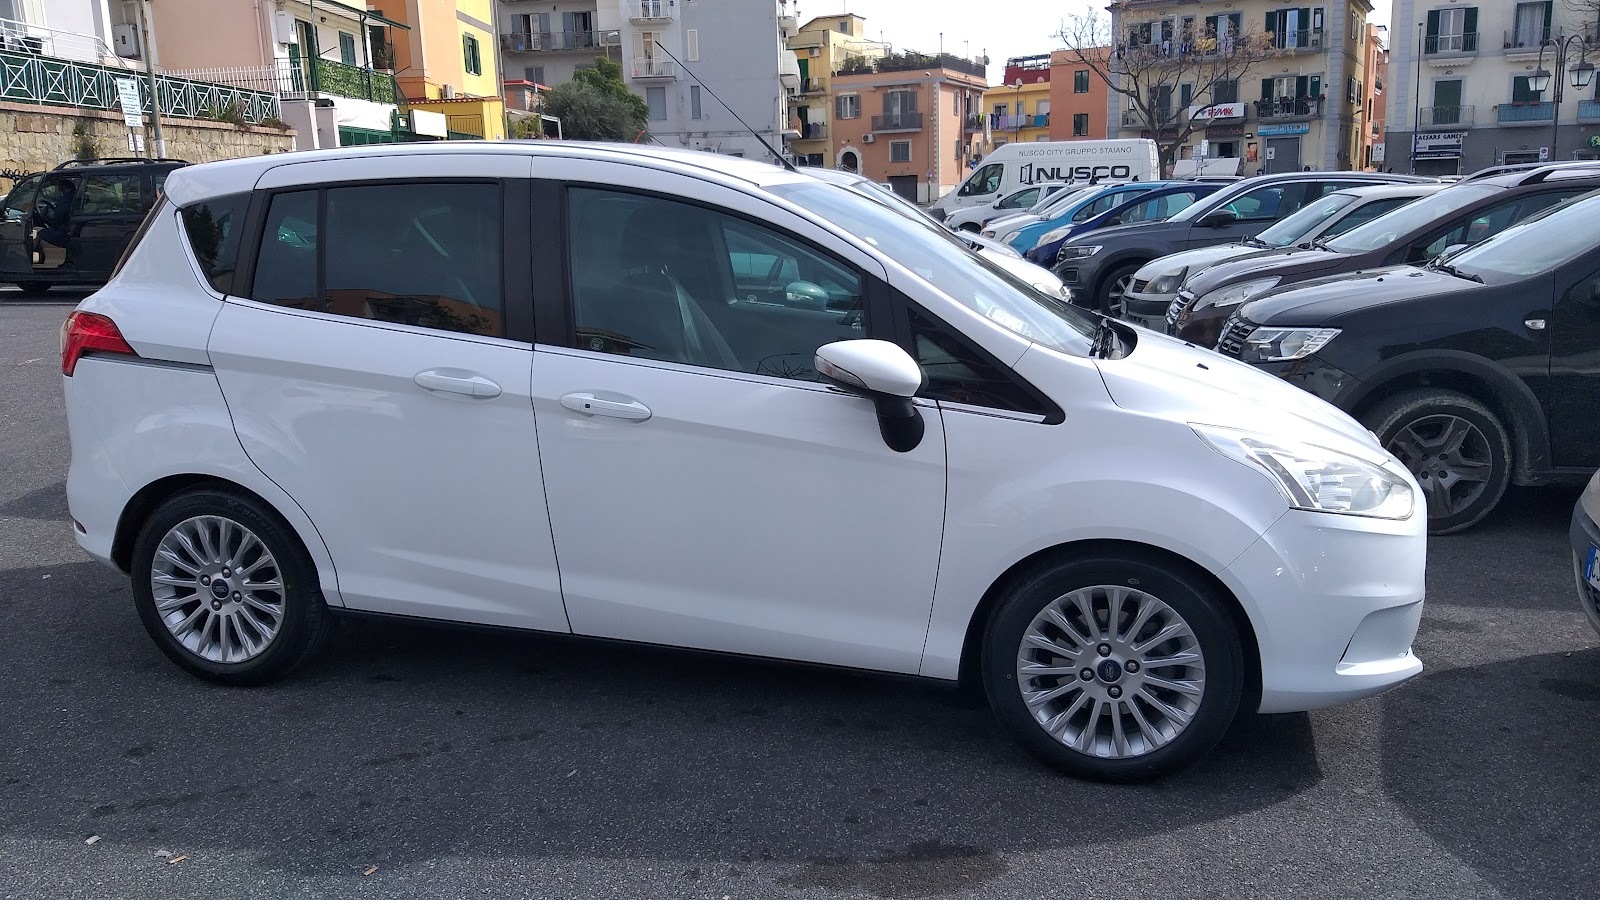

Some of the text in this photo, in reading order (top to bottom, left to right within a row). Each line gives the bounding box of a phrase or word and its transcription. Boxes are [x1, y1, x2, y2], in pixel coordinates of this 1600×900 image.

[1018, 149, 1045, 157] NUSCO
[1064, 147, 1097, 155] GRUPPO
[1098, 146, 1132, 154] STAIANO
[1036, 165, 1130, 181] NUSCO
